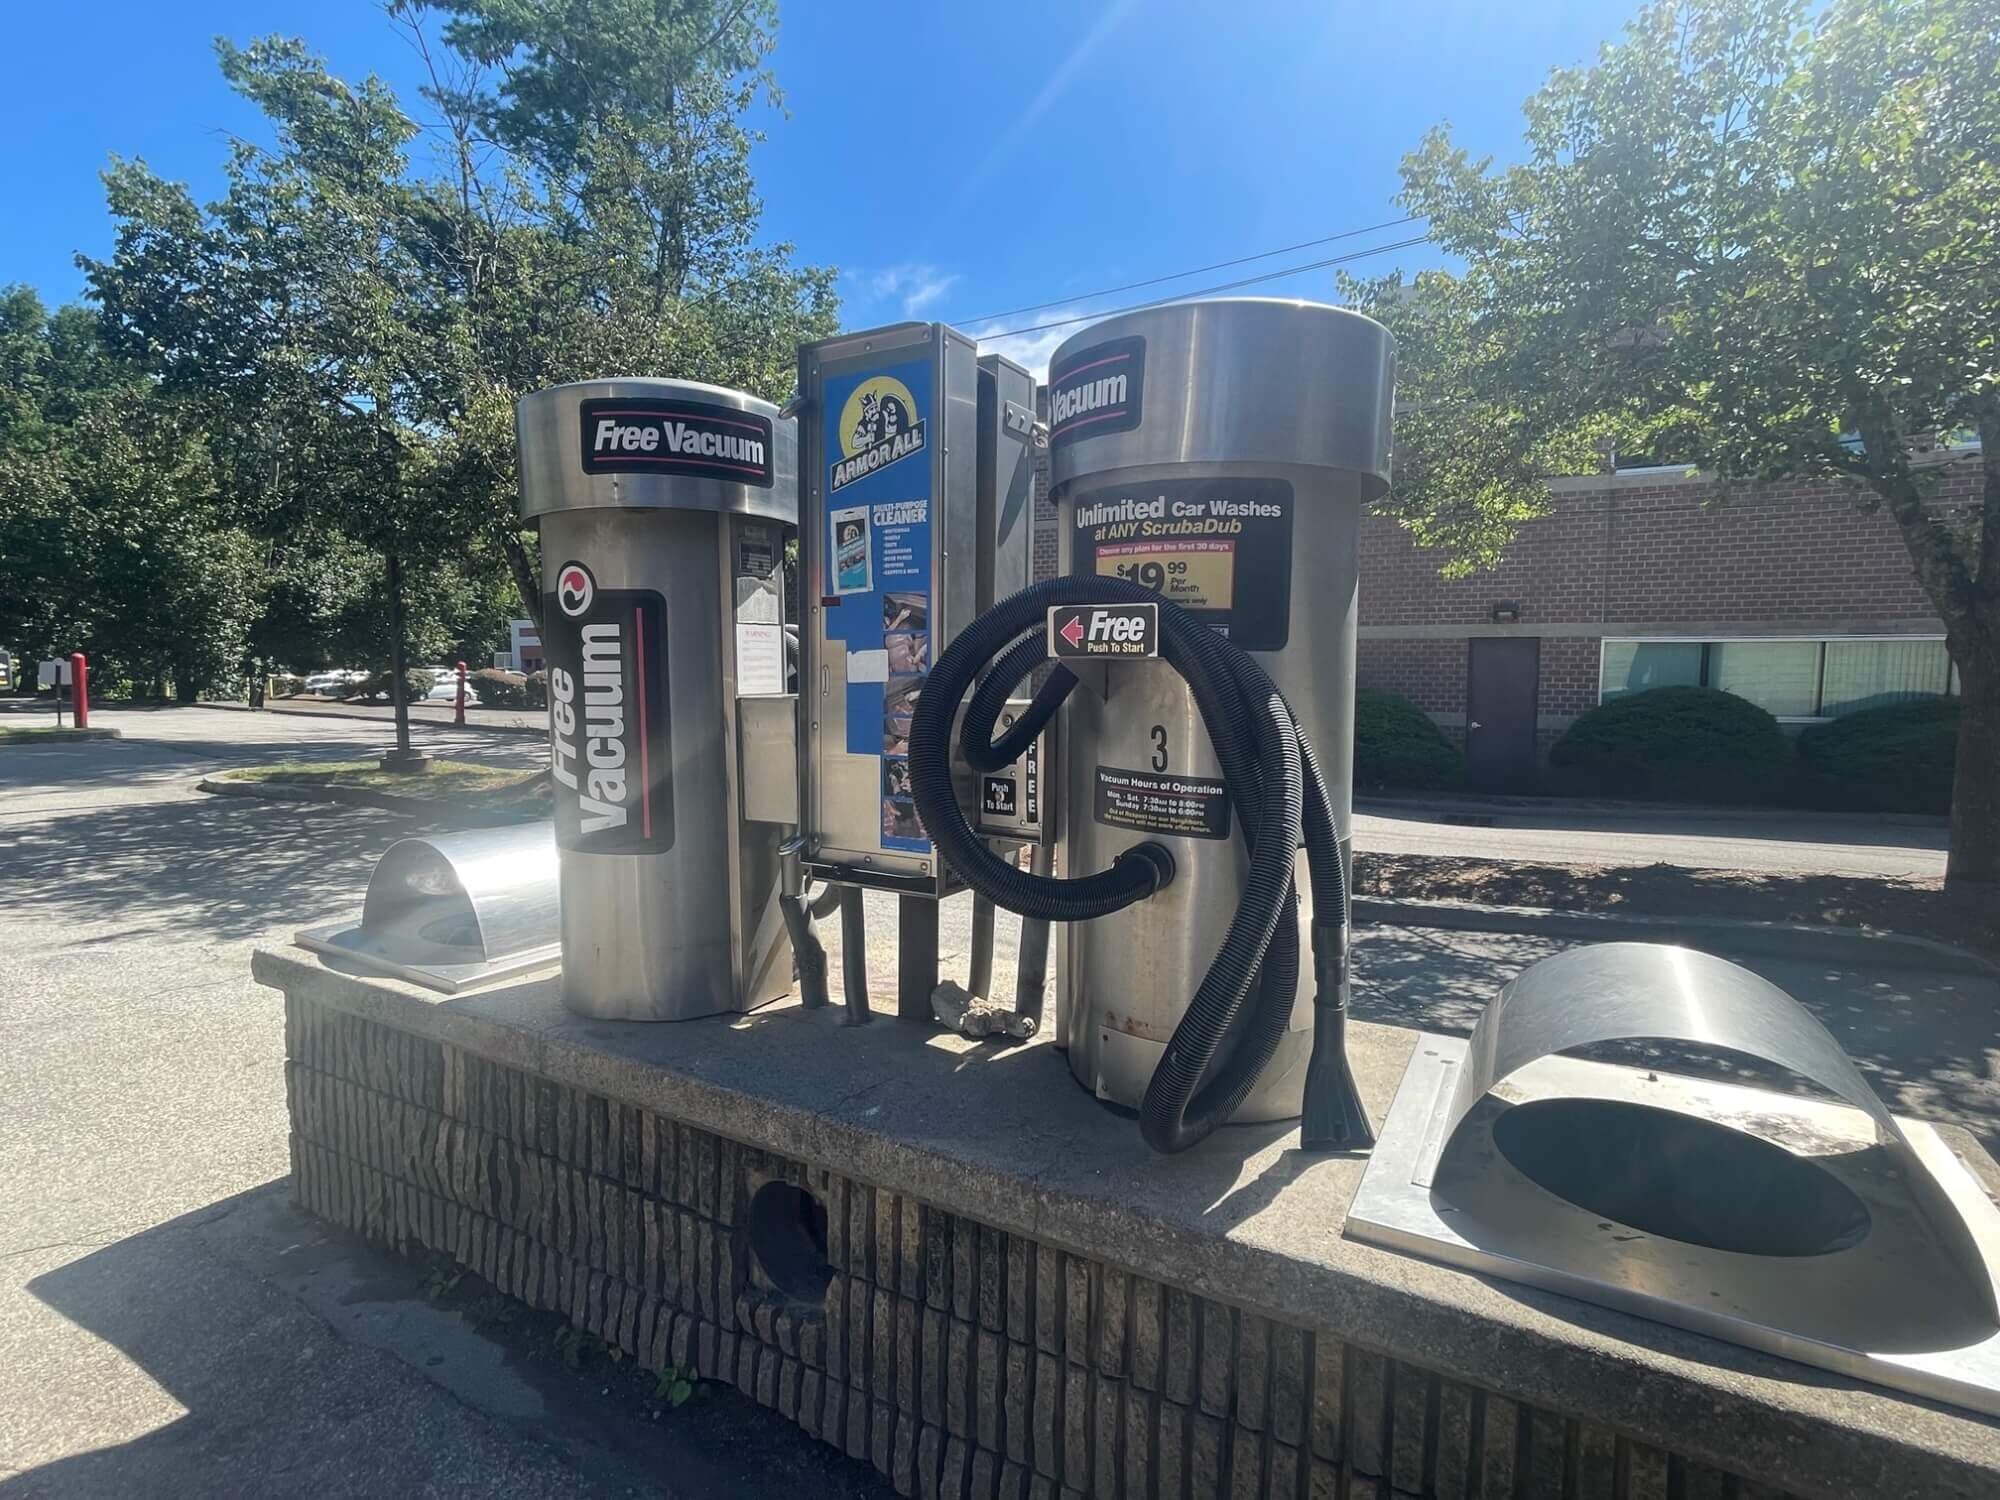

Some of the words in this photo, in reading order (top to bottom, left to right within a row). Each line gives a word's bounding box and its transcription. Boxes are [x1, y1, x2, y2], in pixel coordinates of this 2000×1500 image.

[1052, 374, 1127, 426] Vacuum
[594, 420, 659, 451] Free
[663, 421, 764, 465] Vacuum
[833, 444, 891, 488] ARMOR
[892, 428, 922, 460] ALL
[873, 499, 928, 513] MULTI-PURPOSE
[1077, 495, 1165, 529] Unlimited
[1172, 501, 1206, 518] Car
[1209, 500, 1282, 518] Washes
[873, 509, 927, 526] CLEANER
[1095, 526, 1106, 541] at
[1108, 522, 1139, 539] ANY
[1141, 518, 1242, 537] ScrubaDub
[1209, 542, 1229, 551] days
[1168, 561, 1187, 574] 99
[1170, 577, 1186, 585] Per
[1170, 584, 1200, 593] Month
[1088, 611, 1145, 641] Free
[1088, 642, 1108, 652] Push
[1110, 642, 1120, 652] To
[1122, 642, 1145, 653] Start
[551, 667, 578, 790] Free
[579, 623, 627, 834] Vacuum
[1151, 725, 1168, 772] 3
[1028, 741, 1037, 813] FREE
[1100, 773, 1129, 785] Vacuum
[1131, 777, 1158, 789] Hours
[1160, 782, 1170, 790] of
[1172, 782, 1223, 795] Operation
[991, 782, 1009, 793] Push
[986, 799, 995, 809] To
[995, 800, 1014, 811] Start
[1107, 790, 1121, 799] Mon.
[1127, 793, 1140, 802] Sat.
[1169, 799, 1178, 807] to
[1115, 799, 1140, 810] Sunday
